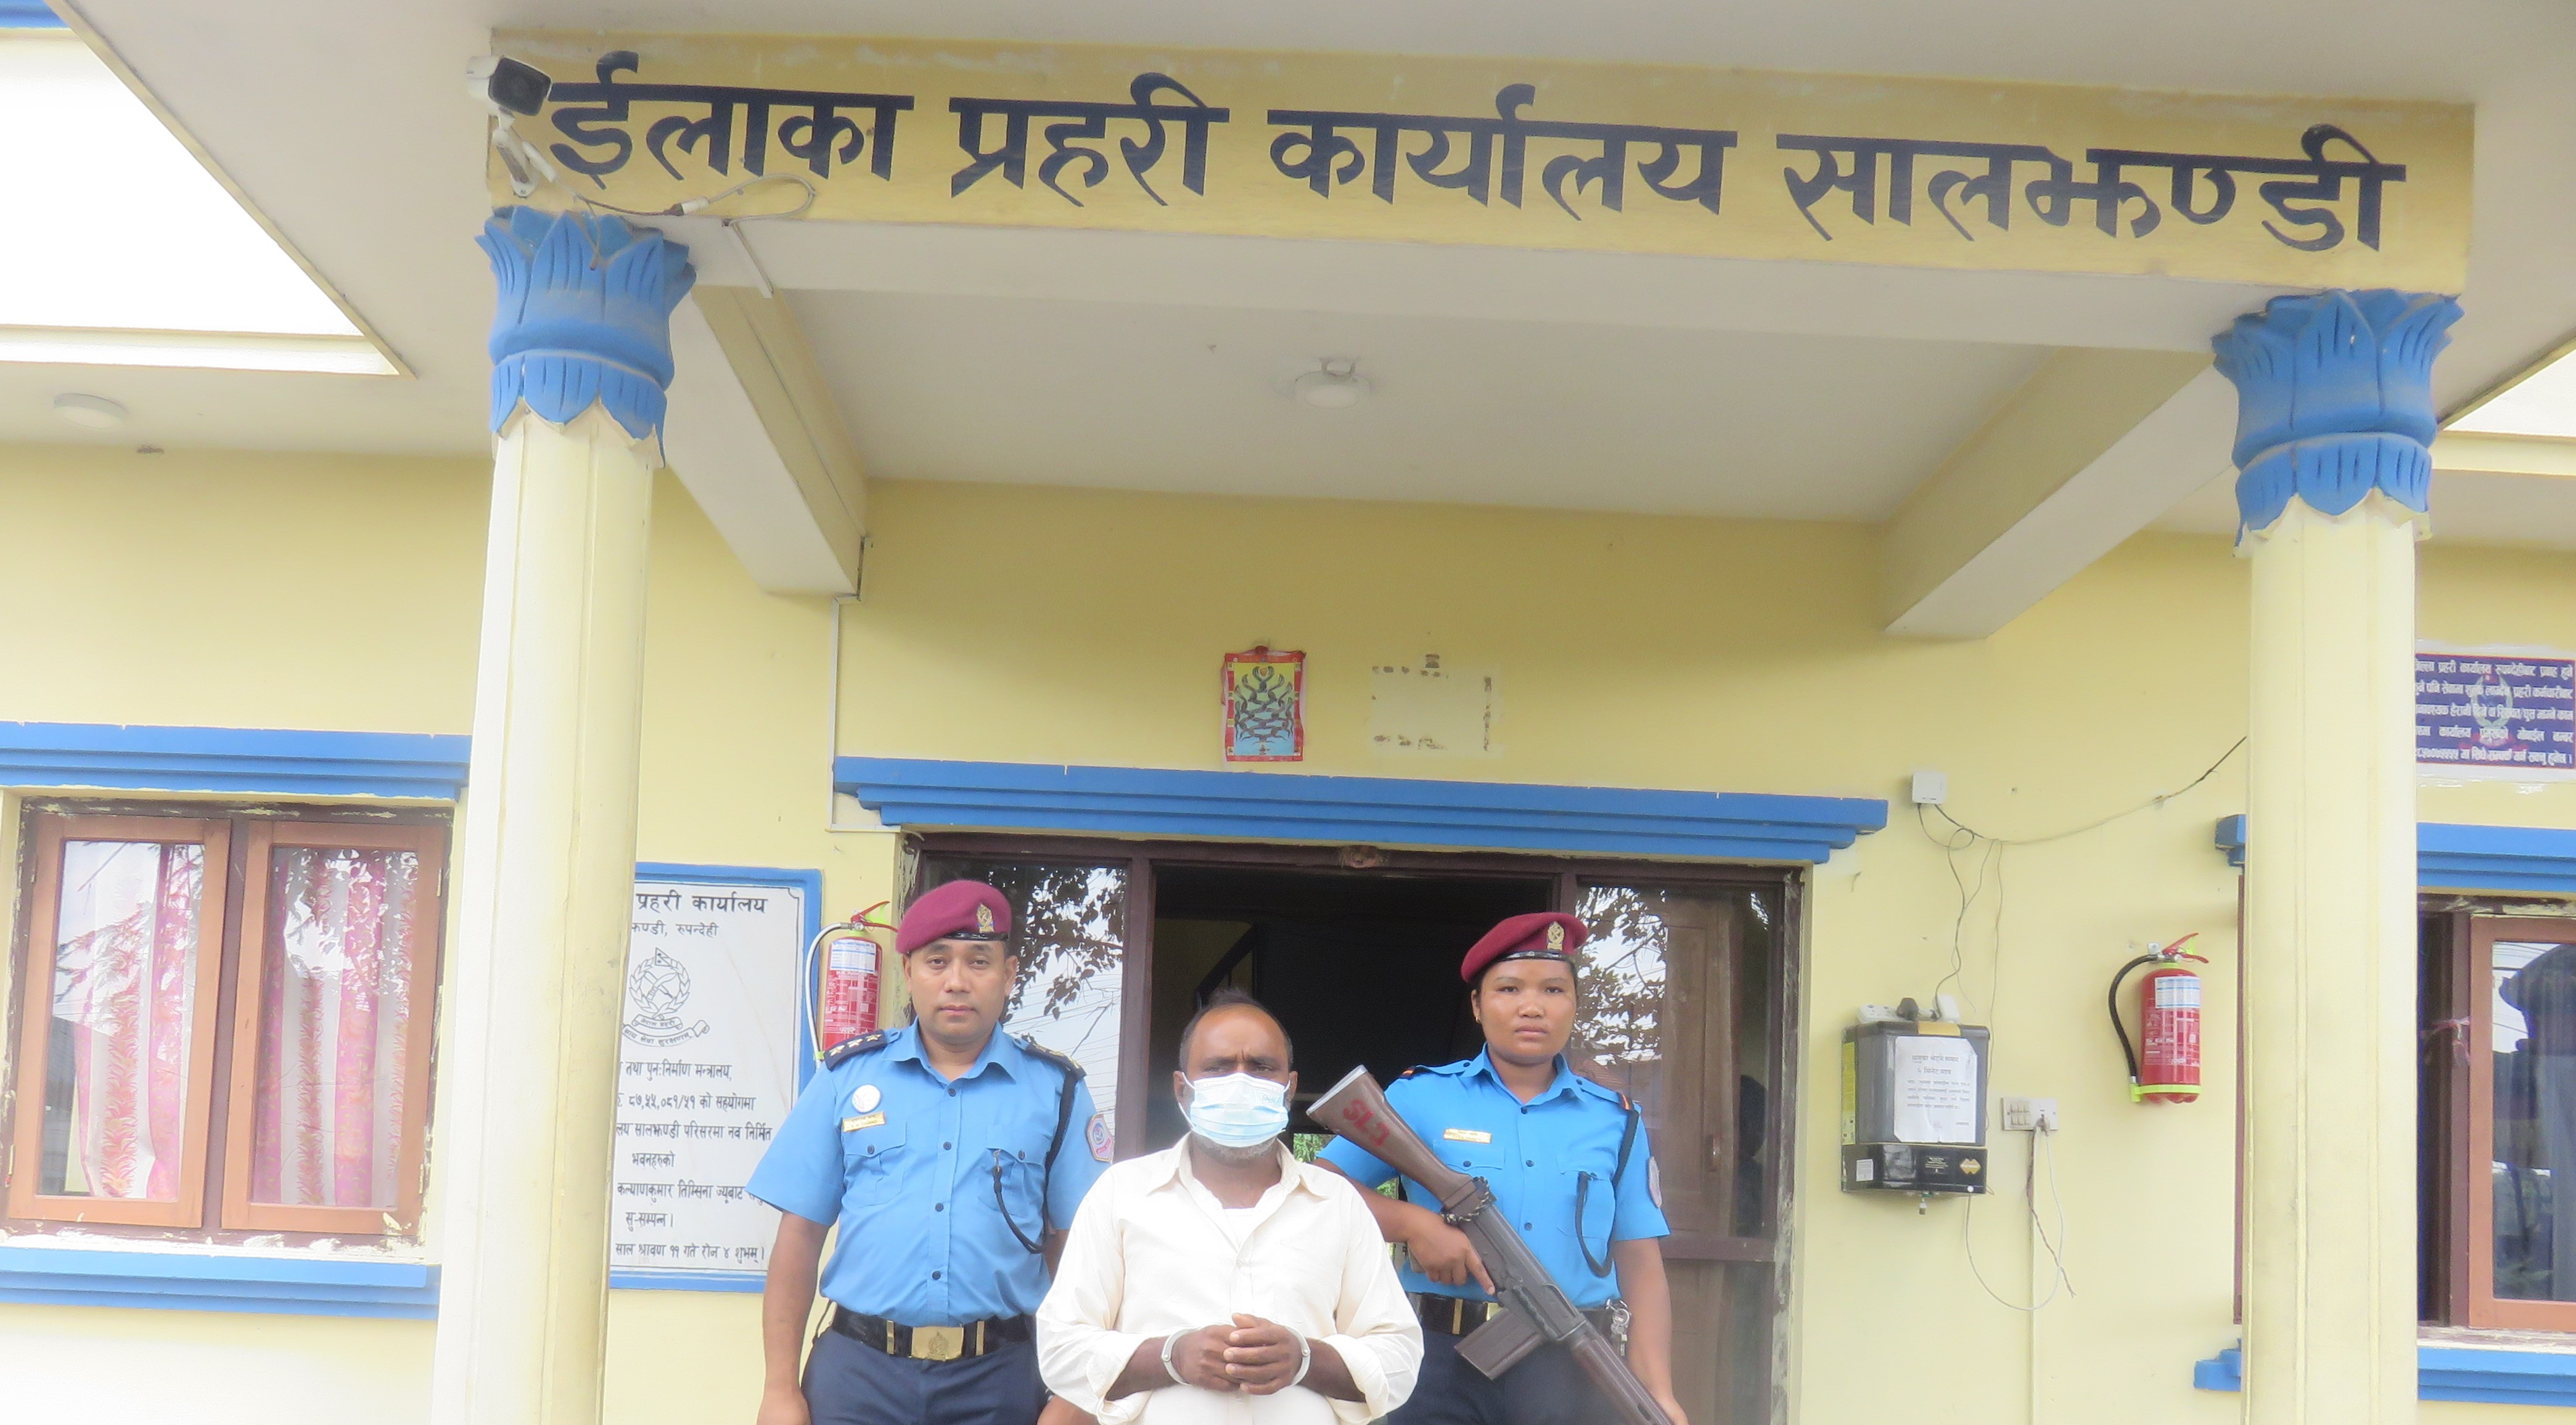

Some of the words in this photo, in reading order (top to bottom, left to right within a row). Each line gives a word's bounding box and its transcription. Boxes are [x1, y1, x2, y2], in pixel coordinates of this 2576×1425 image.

[548, 50, 914, 189] ईलाका
[949, 72, 1229, 206] प्रहरी
[1267, 83, 1737, 221] कार्यालय
[1776, 123, 2406, 251] सालझण्डी
[636, 889, 681, 913] प्रहरी
[692, 891, 768, 913] कार्यालय
[626, 1061, 643, 1076] तथा
[699, 1092, 713, 1109] को
[715, 1092, 757, 1113] सहयोगमा
[684, 1120, 725, 1139] परिसरमा
[728, 1126, 741, 1139] नव
[616, 1243, 636, 1256] साल
[638, 1244, 667, 1258] श्रावण
[670, 1244, 679, 1259] ११
[683, 1243, 699, 1259] गते
[723, 1247, 730, 1259] ४
